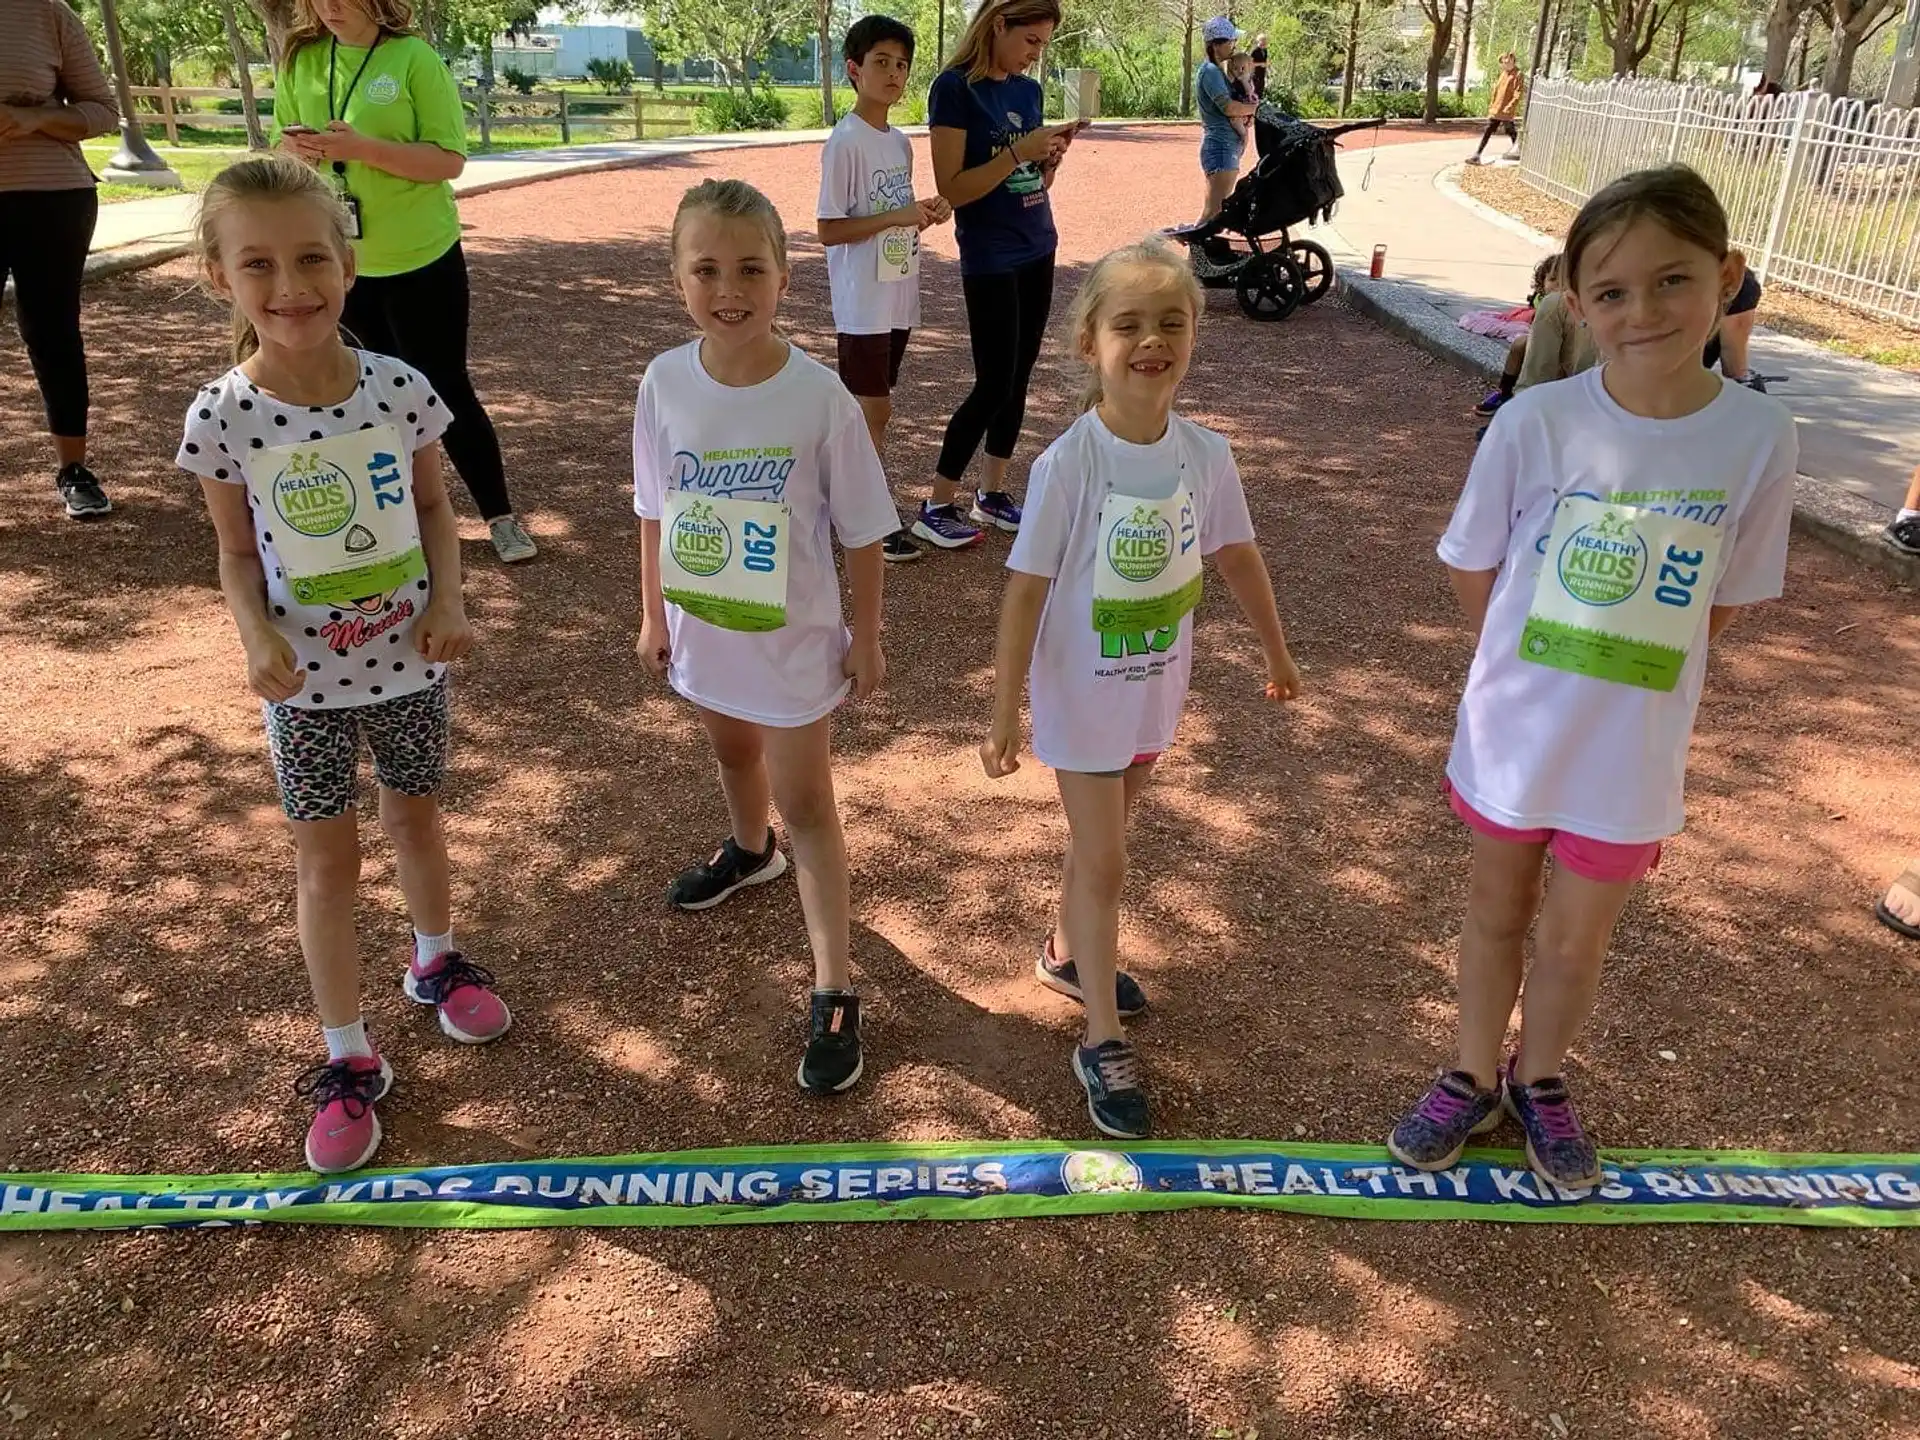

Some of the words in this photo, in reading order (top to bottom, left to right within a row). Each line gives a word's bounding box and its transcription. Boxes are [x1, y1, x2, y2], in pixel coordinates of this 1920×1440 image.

[703, 448, 759, 461] HEALTHY
[763, 447, 793, 457] KIDS
[279, 471, 338, 492] HEALTHY
[366, 452, 405, 510] 412
[672, 450, 796, 495] Running
[283, 484, 345, 512] KIDS
[1607, 489, 1685, 504] HEALTHY
[1688, 488, 1726, 501] KIDS
[295, 510, 347, 526] RUNNING
[678, 521, 722, 535] HEALTHY
[677, 531, 723, 554] KIDS
[1117, 527, 1167, 538] HEALTHY
[743, 521, 777, 573] 290
[1115, 538, 1166, 557] KIDS
[1575, 535, 1641, 557] HEALTHY
[1568, 548, 1636, 580] KIDS
[1569, 576, 1625, 596] RUNNING
[1654, 544, 1703, 608] 320
[1094, 666, 1127, 676] HEALTHY
[490, 1169, 781, 1205] RUNNING
[800, 1162, 1008, 1199] SERIES
[1197, 1162, 1471, 1197] HEALTHY
[1641, 1171, 1919, 1202] RUNNING
